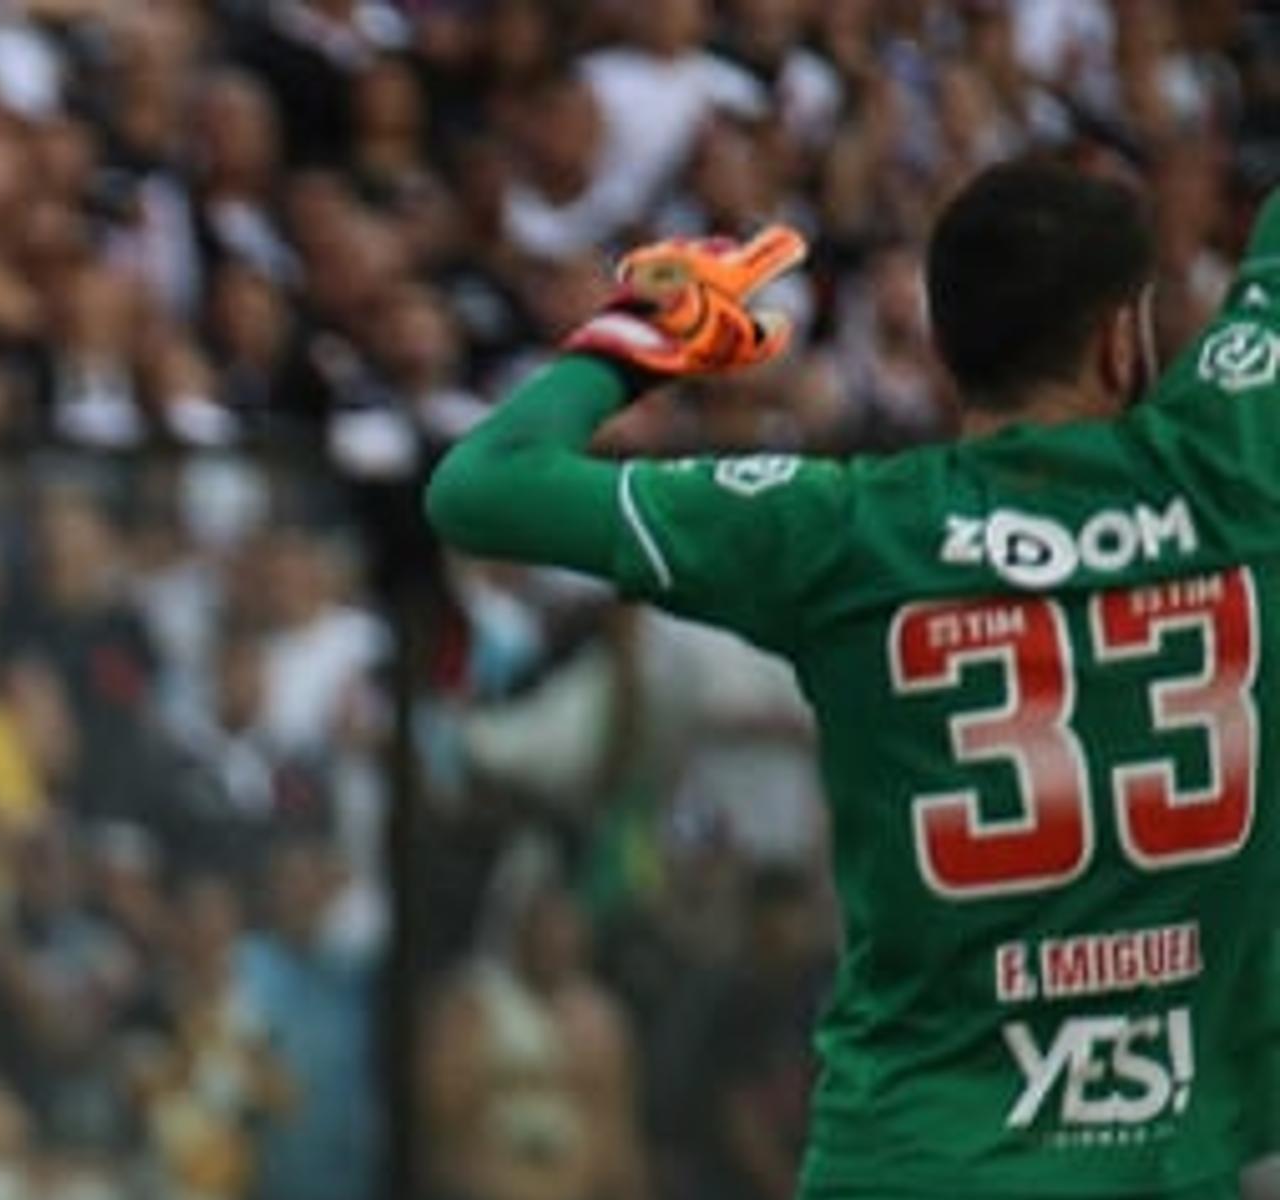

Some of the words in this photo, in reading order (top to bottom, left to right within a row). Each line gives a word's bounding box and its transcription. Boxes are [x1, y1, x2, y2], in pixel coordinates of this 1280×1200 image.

[888, 565, 1260, 900] 33
[995, 939, 1039, 1002] F.
[1040, 919, 1204, 998] MIGUEL
[1001, 1006, 1195, 1129] YES!
